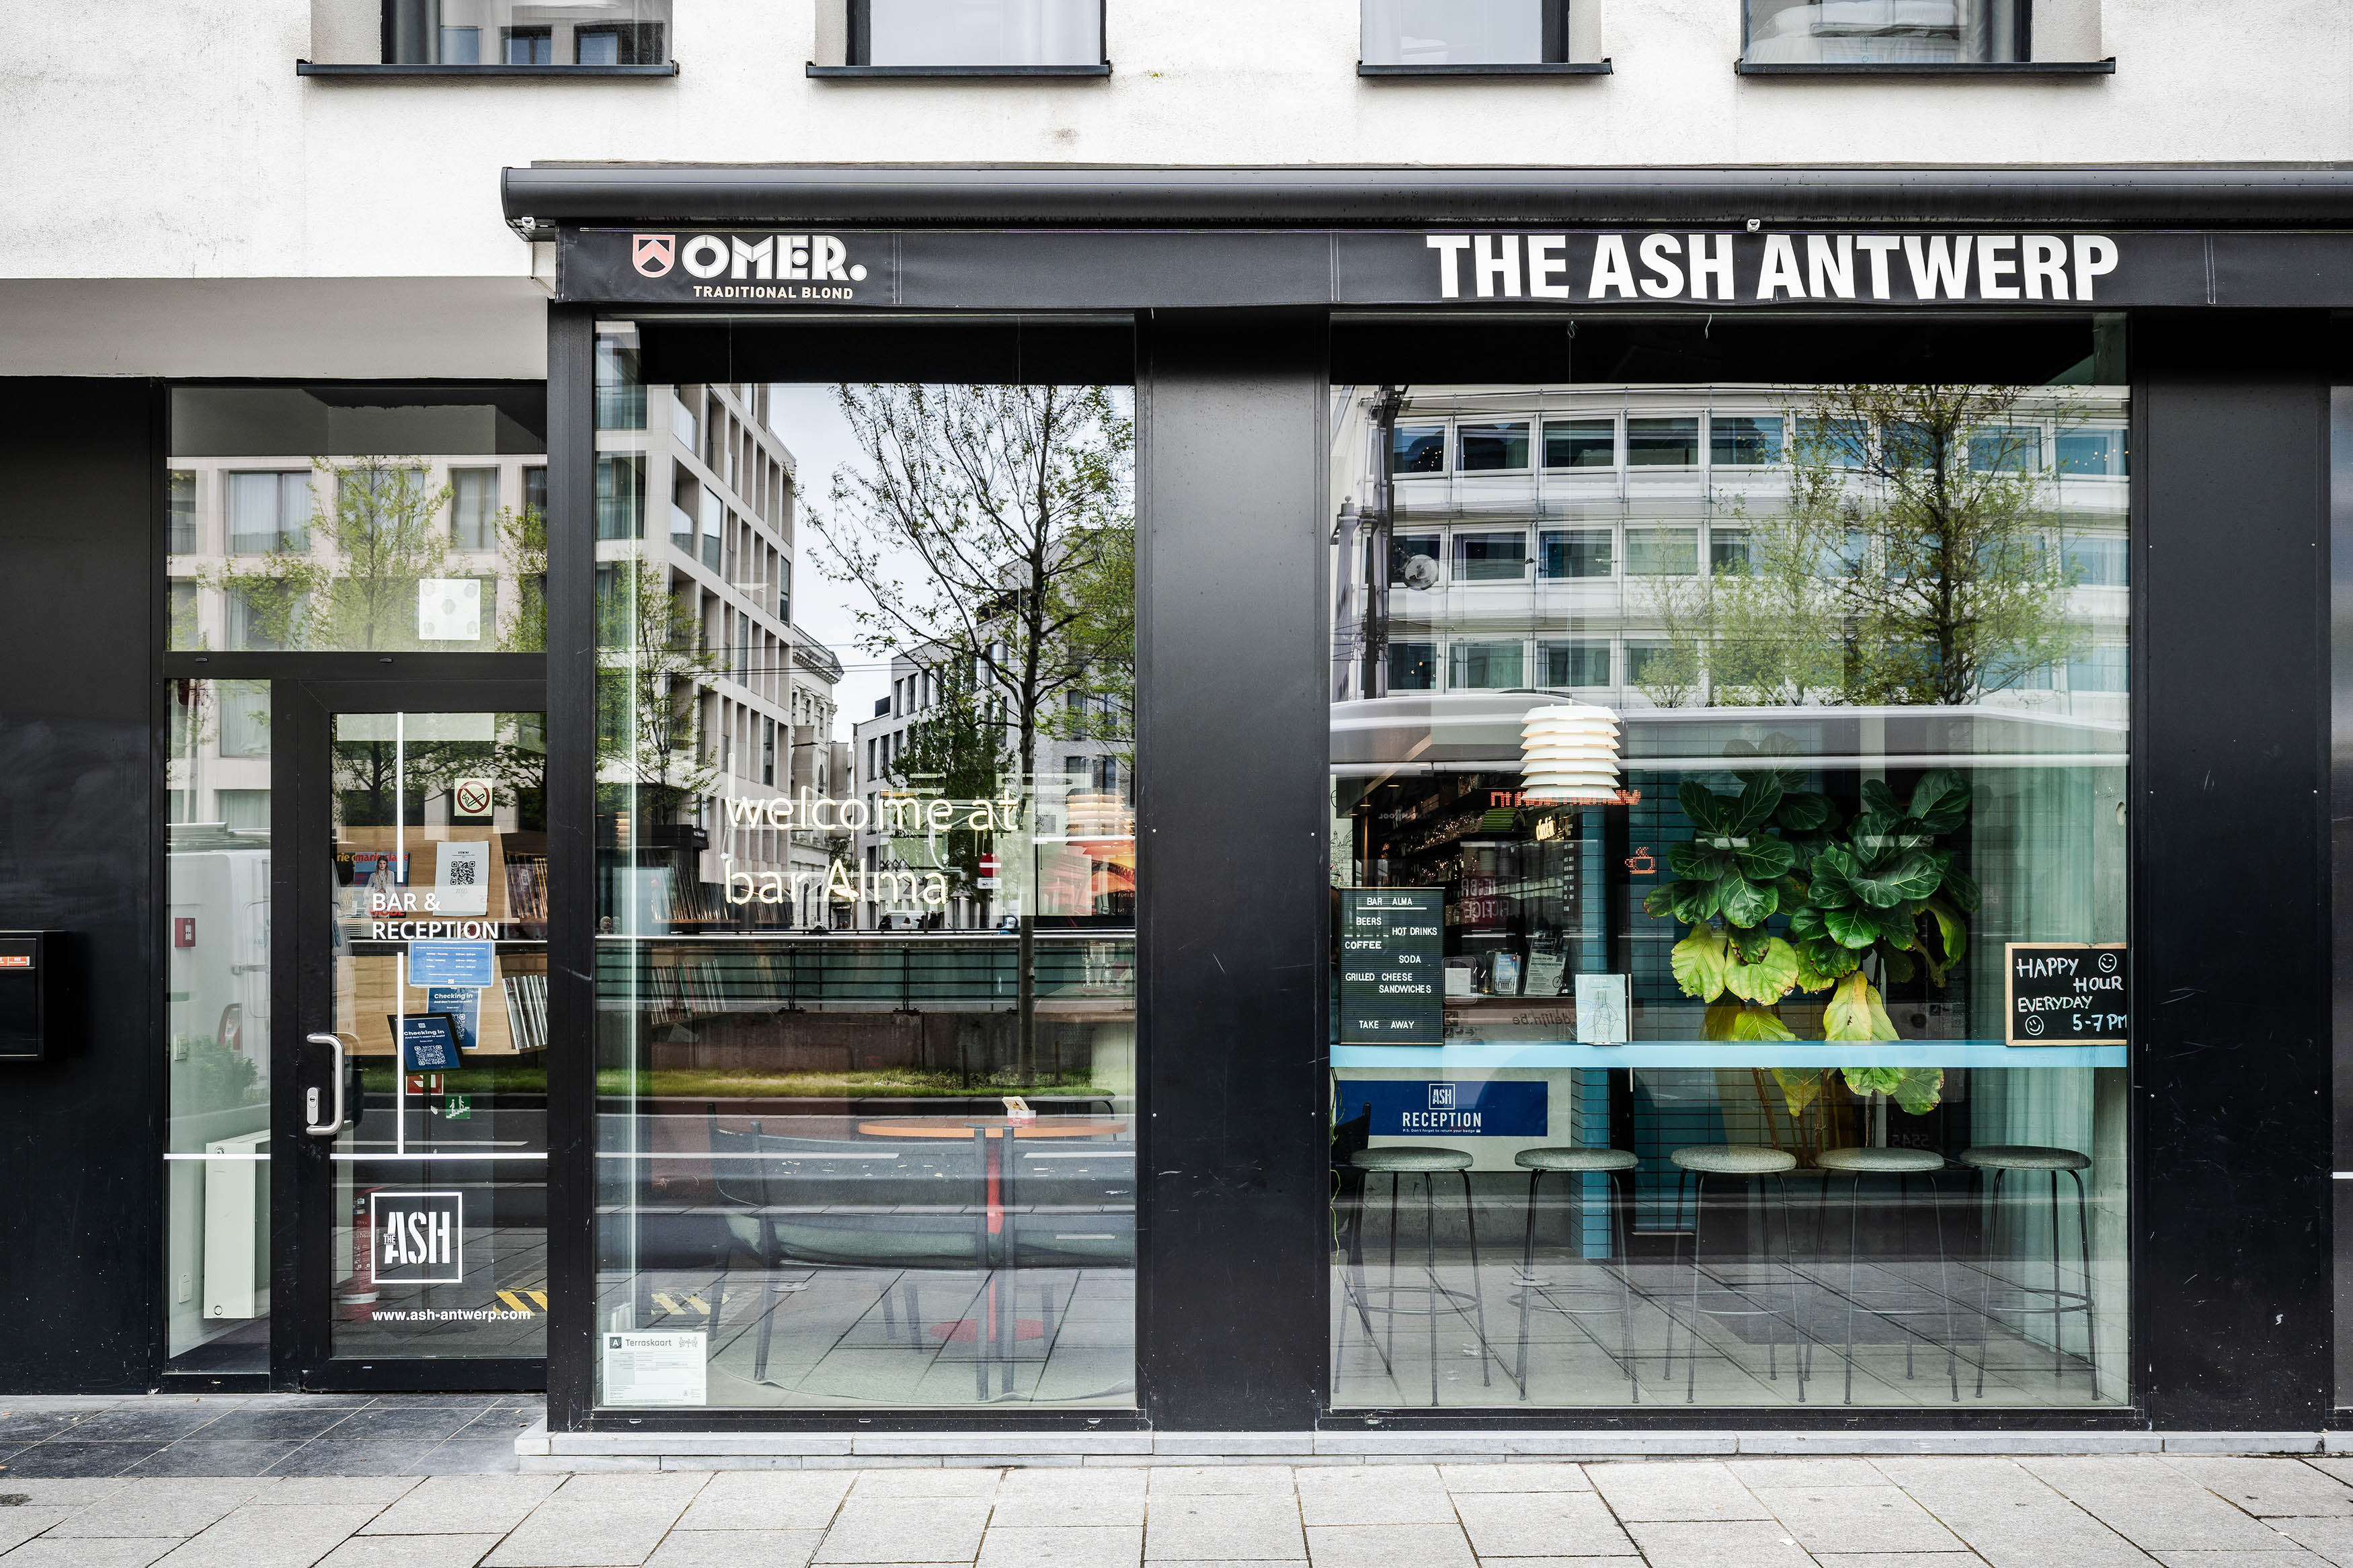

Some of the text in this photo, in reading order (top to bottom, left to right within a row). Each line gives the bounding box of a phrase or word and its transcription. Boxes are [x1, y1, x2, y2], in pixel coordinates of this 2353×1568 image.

[681, 235, 867, 281] OMER.
[1425, 233, 2120, 302] THE ASH ANTWERP
[693, 286, 854, 300] TRADITIONAL BLOND
[725, 785, 1020, 832] welcome at
[725, 857, 949, 905] bar Alma
[372, 893, 441, 911] BAR &
[1367, 897, 1412, 906] BAR ALMA
[1356, 917, 1382, 925] BEERS
[372, 921, 499, 940] RECEPTION
[1392, 927, 1437, 936] HOT DRINKS
[1345, 941, 1382, 950] COFFEE
[1399, 955, 1421, 963] SODA
[2016, 957, 2079, 978] HAPPY
[1345, 973, 1412, 981] GRILLED CHEESE
[2073, 975, 2124, 992] HOUR
[1379, 985, 1431, 994] SANDWICHES
[2018, 995, 2093, 1012] EVERYDAY
[1359, 1020, 1414, 1030] TAKE AWAY
[2073, 1014, 2128, 1032] 5-7 PM
[1433, 1089, 1451, 1104] ASH
[1402, 1112, 1482, 1127] RECEPTION
[384, 1212, 450, 1264] ASH
[384, 1235, 396, 1243] THE
[372, 1309, 531, 1322] www.ash-antwerp.com
[625, 1339, 672, 1347] Terraskaart
